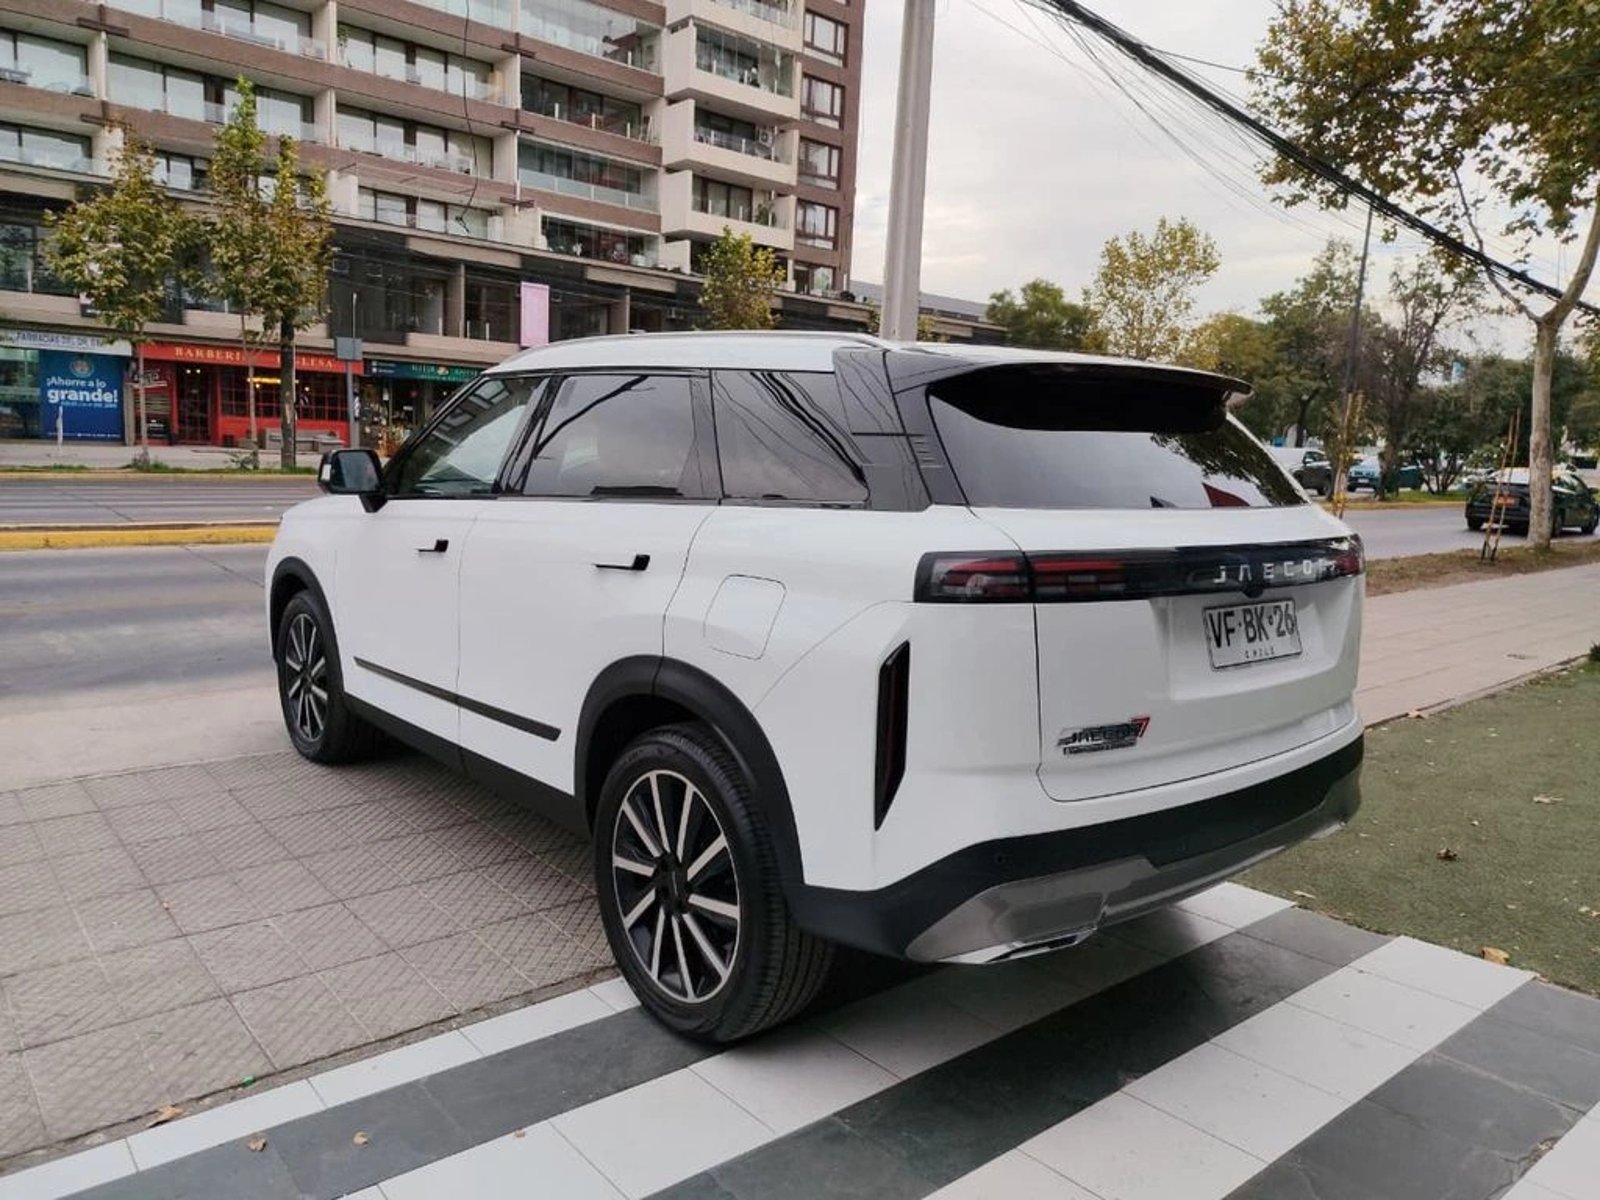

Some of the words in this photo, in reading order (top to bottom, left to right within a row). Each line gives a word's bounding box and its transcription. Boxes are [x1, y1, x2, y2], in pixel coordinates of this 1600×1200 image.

[276, 354, 334, 368] ILESA
[96, 379, 107, 388] lo
[47, 388, 118, 404] grande!
